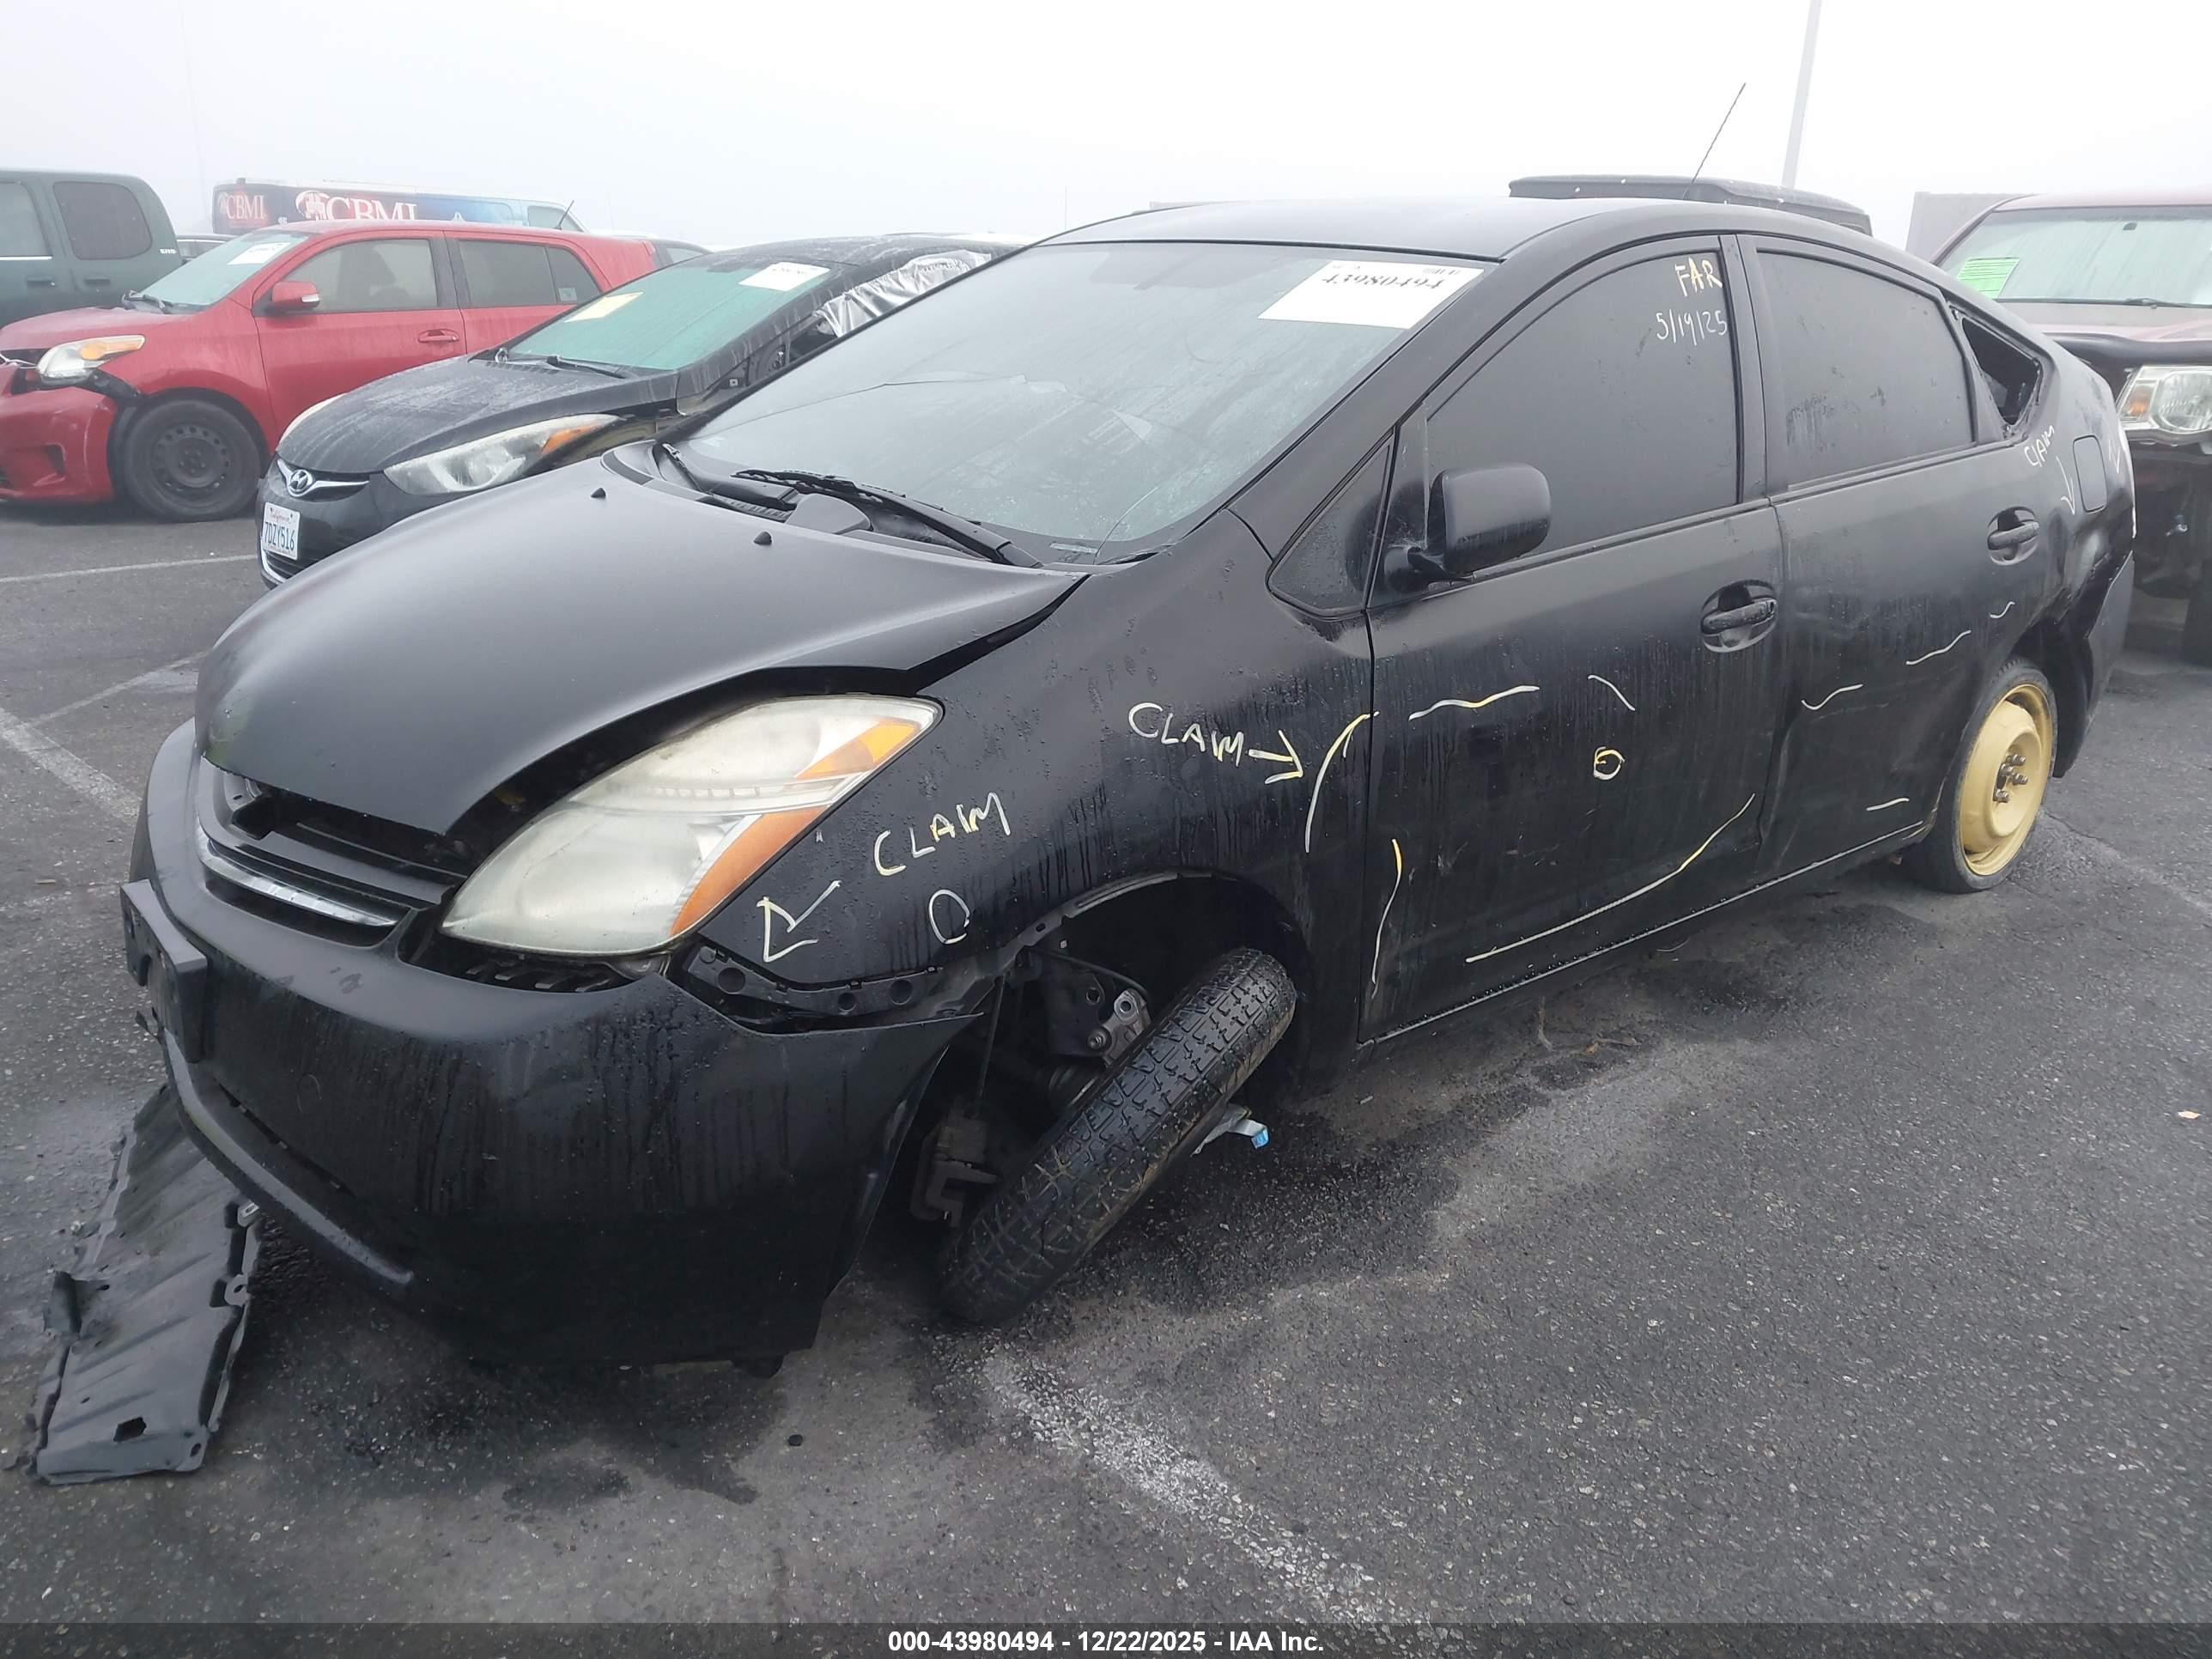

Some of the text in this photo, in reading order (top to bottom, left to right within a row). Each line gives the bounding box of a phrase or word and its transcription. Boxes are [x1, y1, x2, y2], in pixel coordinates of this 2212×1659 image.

[227, 194, 265, 220] CBMI
[326, 196, 417, 221] CBMI
[1674, 257, 1723, 297] FAR
[1656, 308, 1728, 346] 5/19/25
[264, 521, 295, 550] 7DZY516
[874, 792, 1011, 877] CLAIM
